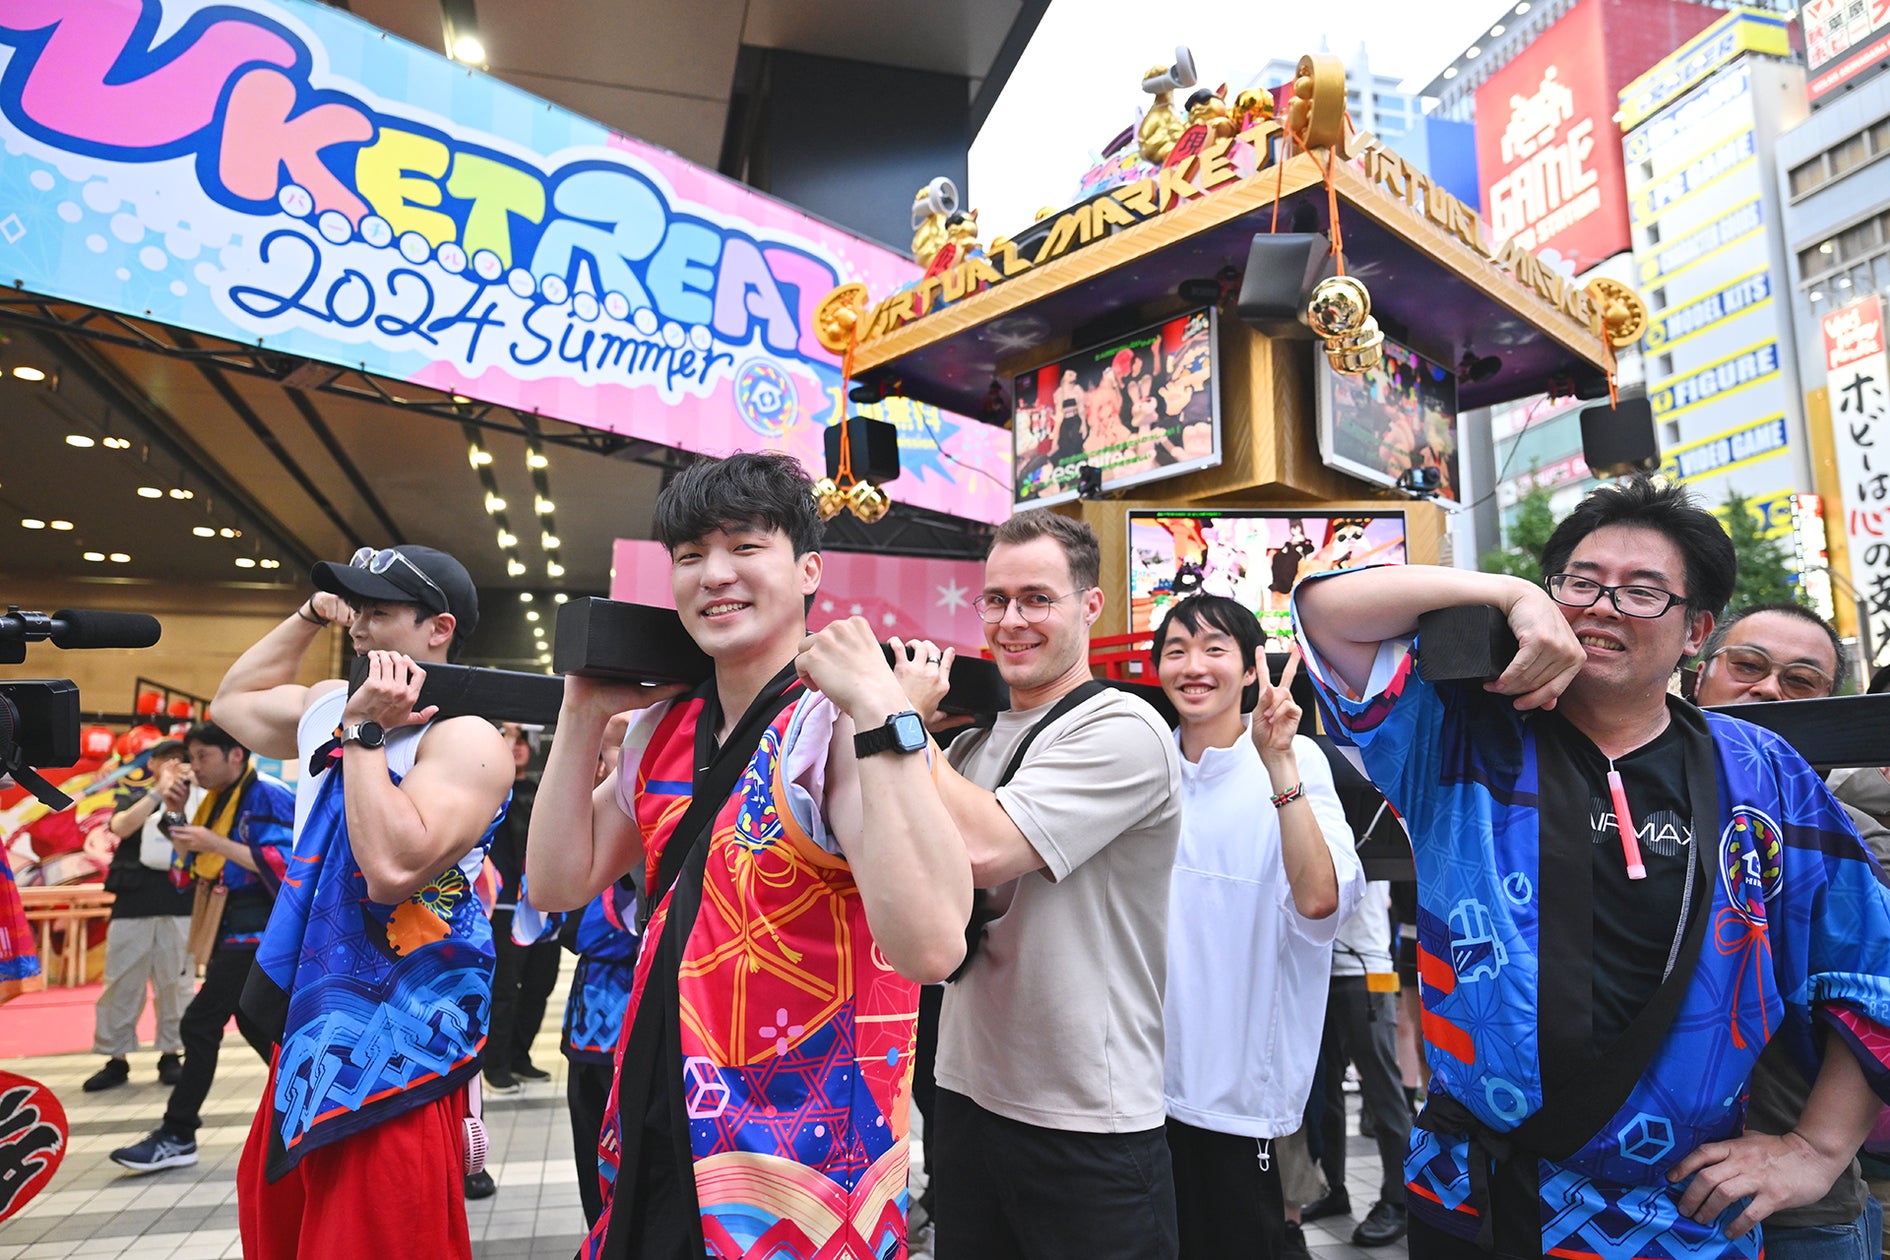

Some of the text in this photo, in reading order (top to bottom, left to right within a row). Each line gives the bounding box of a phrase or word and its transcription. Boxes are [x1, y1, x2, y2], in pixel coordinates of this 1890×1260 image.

[856, 120, 1284, 343] VIRTUAL MARKET
[1343, 127, 1604, 338] VIRTUAL MARKET
[1490, 118, 1598, 242] GAME
[229, 229, 506, 363] 2024
[1667, 274, 1768, 341] MODEL KITS
[1674, 344, 1776, 407] FIGURE
[1679, 419, 1784, 477] VIDEO GAME
